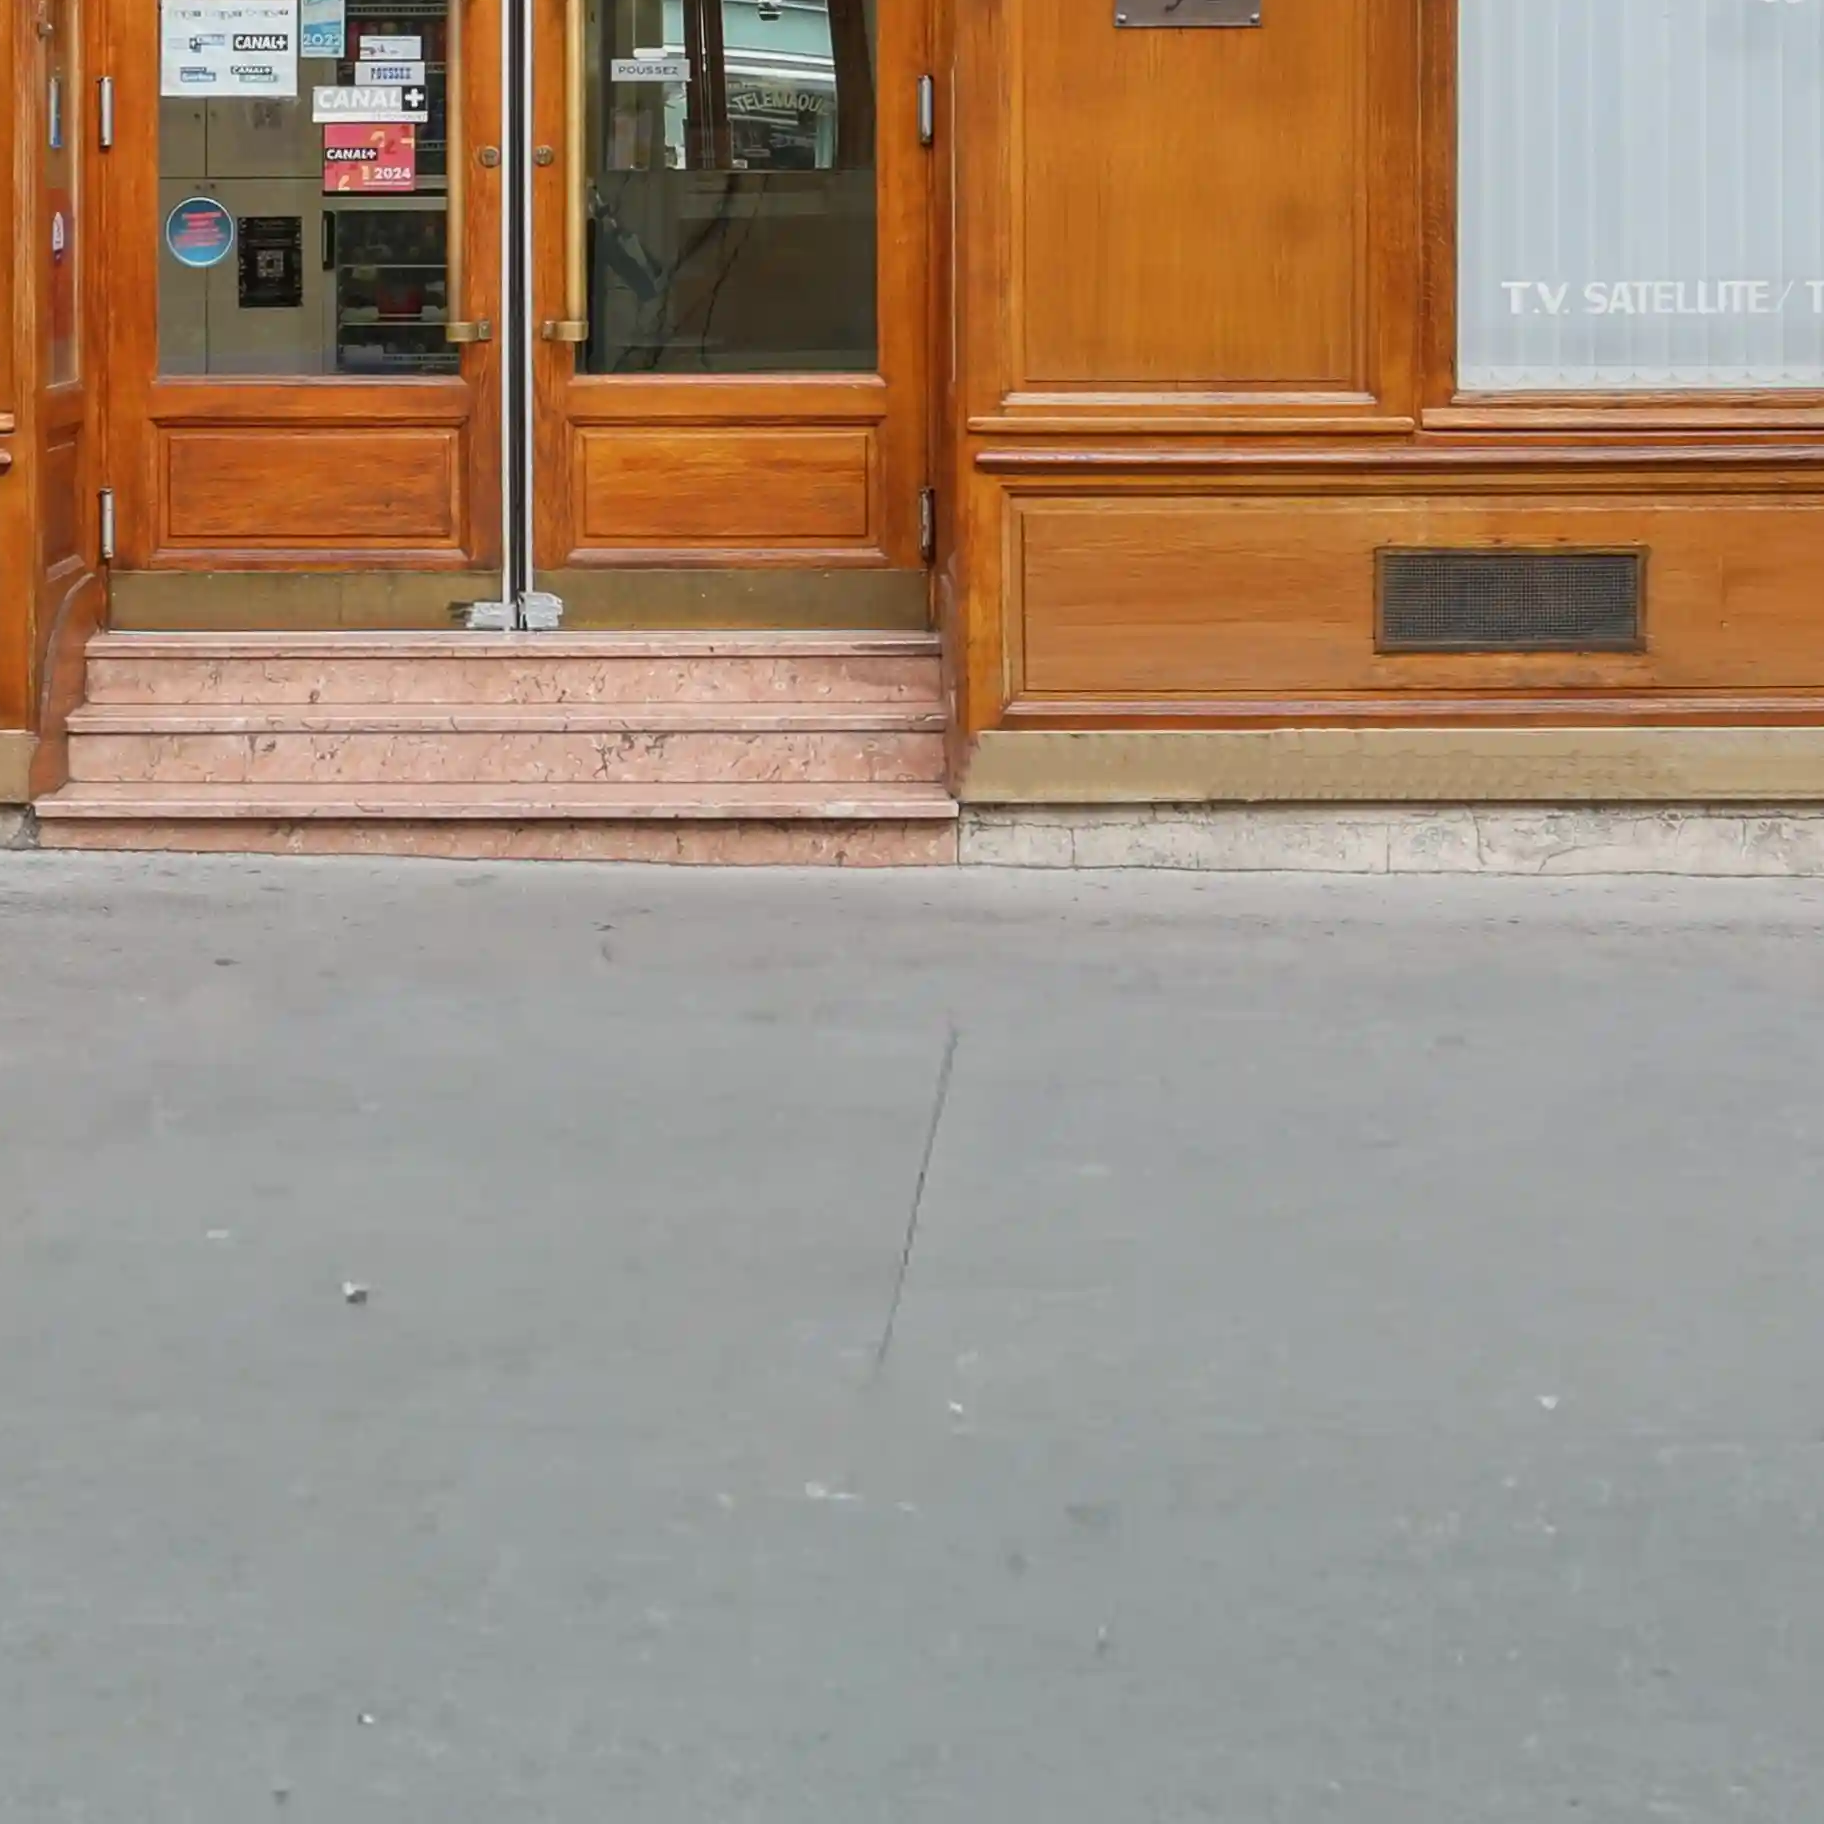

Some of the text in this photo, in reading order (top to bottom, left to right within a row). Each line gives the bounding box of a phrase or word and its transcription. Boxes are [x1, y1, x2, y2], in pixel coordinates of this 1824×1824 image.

[234, 35, 286, 50] CANAL+
[617, 65, 679, 76] POUSSEZ
[326, 148, 377, 160] CANAL+
[374, 167, 412, 180] 2024
[1501, 281, 1572, 316] T.V.
